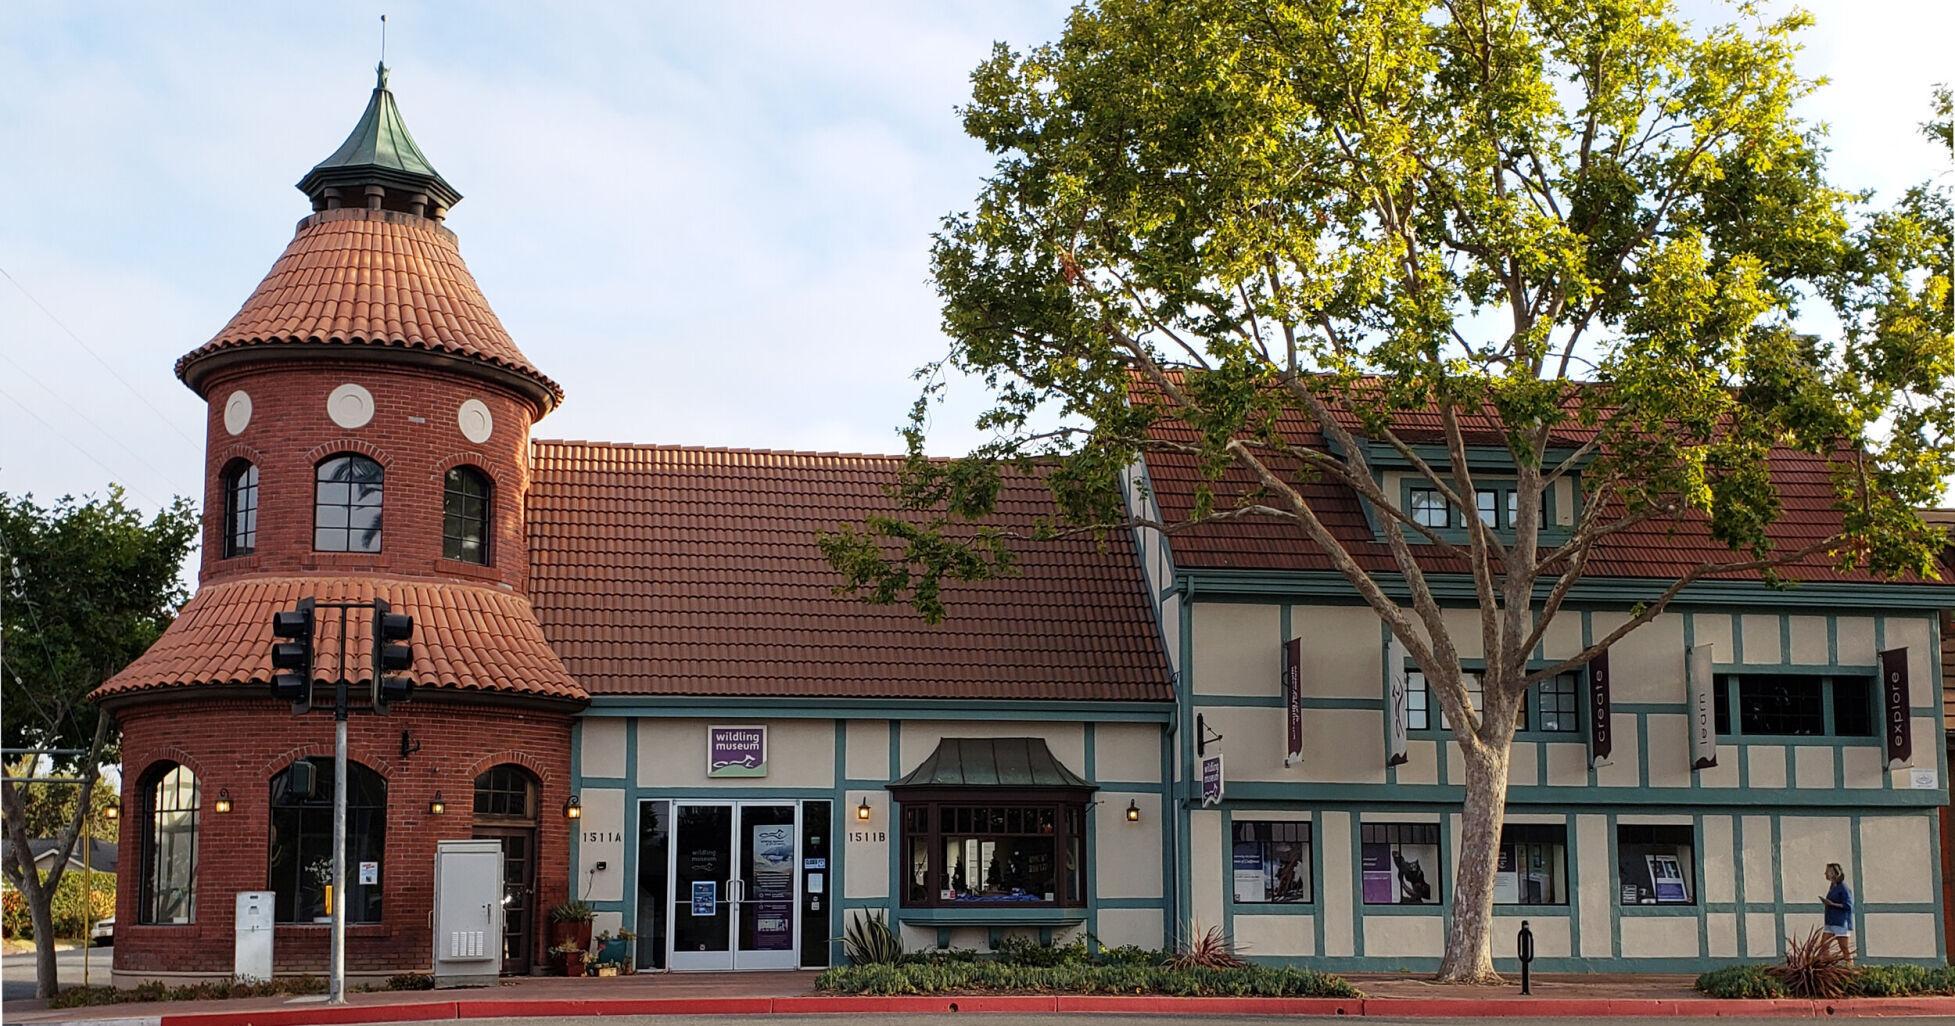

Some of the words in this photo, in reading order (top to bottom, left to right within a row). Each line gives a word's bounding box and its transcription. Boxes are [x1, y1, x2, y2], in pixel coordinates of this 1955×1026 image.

[1595, 670, 1606, 742] create
[1891, 671, 1904, 747] explore
[1699, 693, 1708, 745] learn
[715, 731, 760, 744] wildling
[715, 743, 760, 751] museum
[583, 832, 622, 843] 1511A
[849, 832, 886, 843] 1511B
